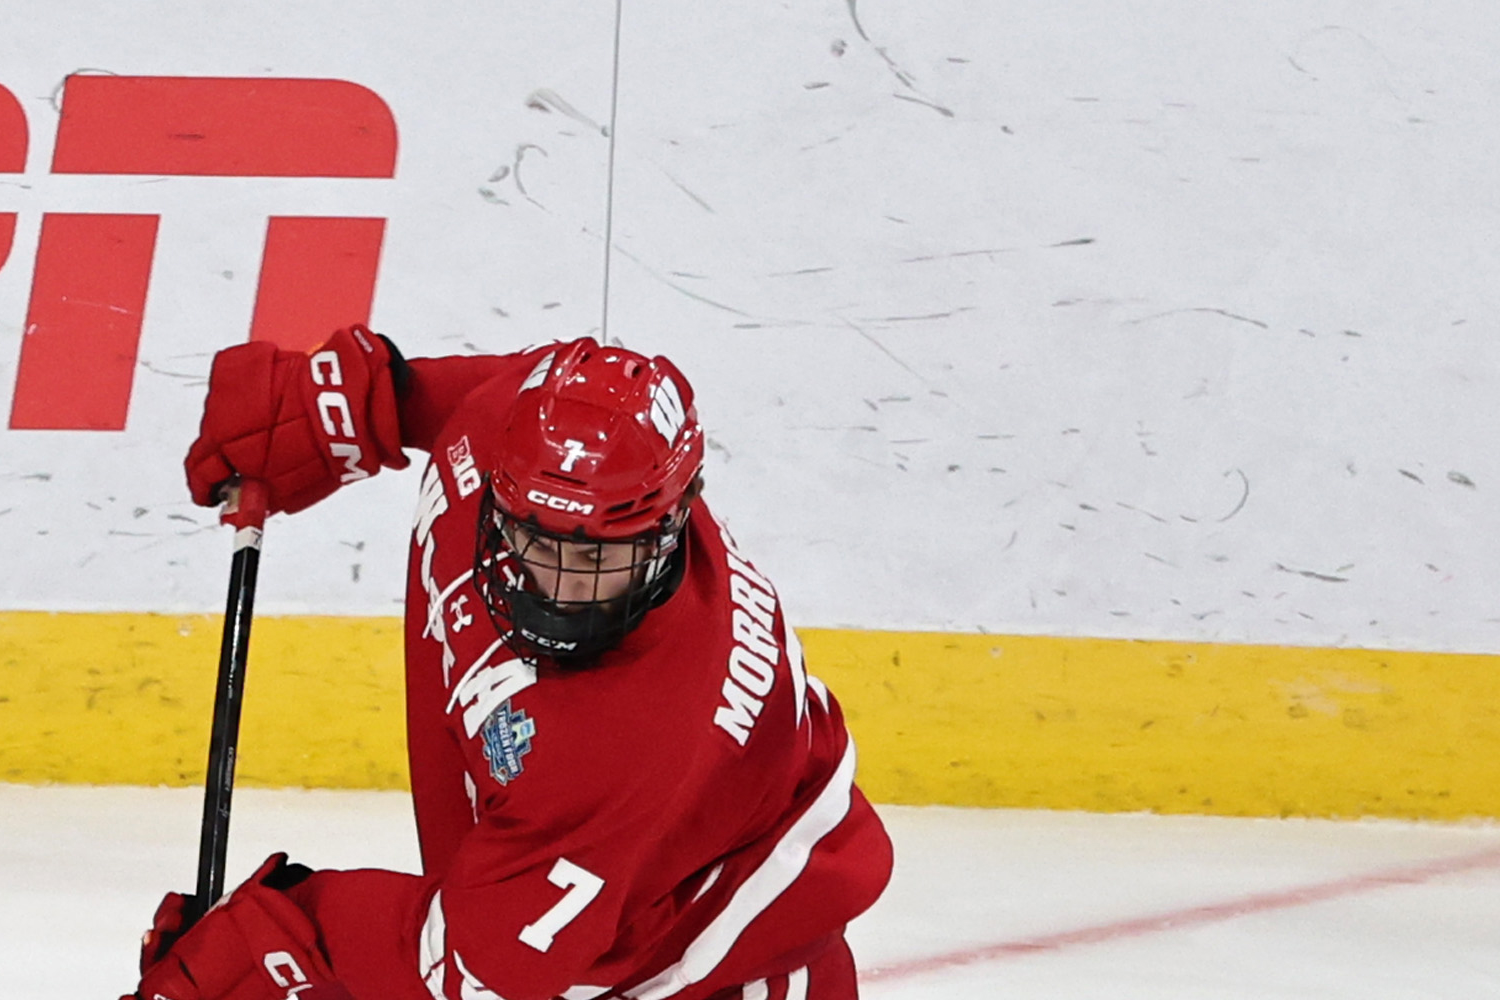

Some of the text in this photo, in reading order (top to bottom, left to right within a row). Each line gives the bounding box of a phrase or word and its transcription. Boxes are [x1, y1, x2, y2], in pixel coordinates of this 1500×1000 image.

[310, 350, 369, 483] CCM
[560, 439, 586, 472] 7
[527, 489, 595, 515] CCM
[518, 856, 606, 953] 7
